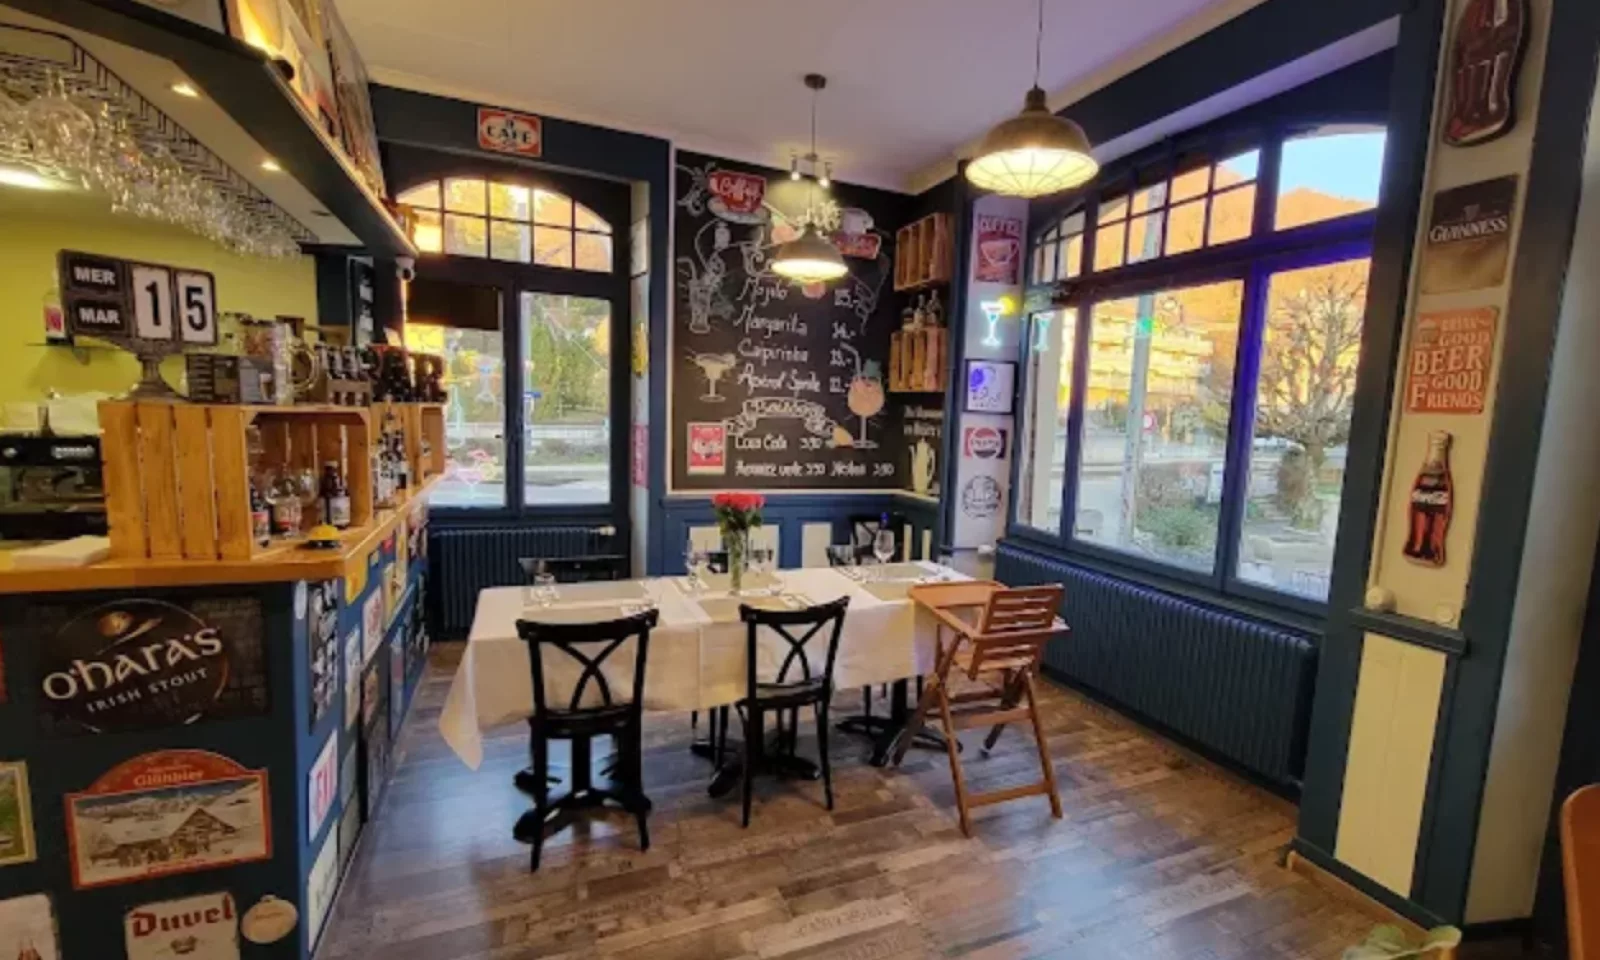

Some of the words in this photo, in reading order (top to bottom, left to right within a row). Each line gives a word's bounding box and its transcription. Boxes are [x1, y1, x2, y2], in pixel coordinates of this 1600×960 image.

[1429, 215, 1508, 244] GUINNESS
[73, 266, 116, 286] MER
[78, 306, 121, 326] MAR
[733, 302, 808, 338] Margarita
[1438, 331, 1490, 347] GOOD
[1412, 346, 1484, 375] BEER
[1432, 371, 1482, 391] GOOD
[1410, 384, 1482, 408] FRIENDS
[86, 690, 142, 713] IRISH
[148, 667, 208, 693] STOUT
[131, 894, 234, 938] Duvel
